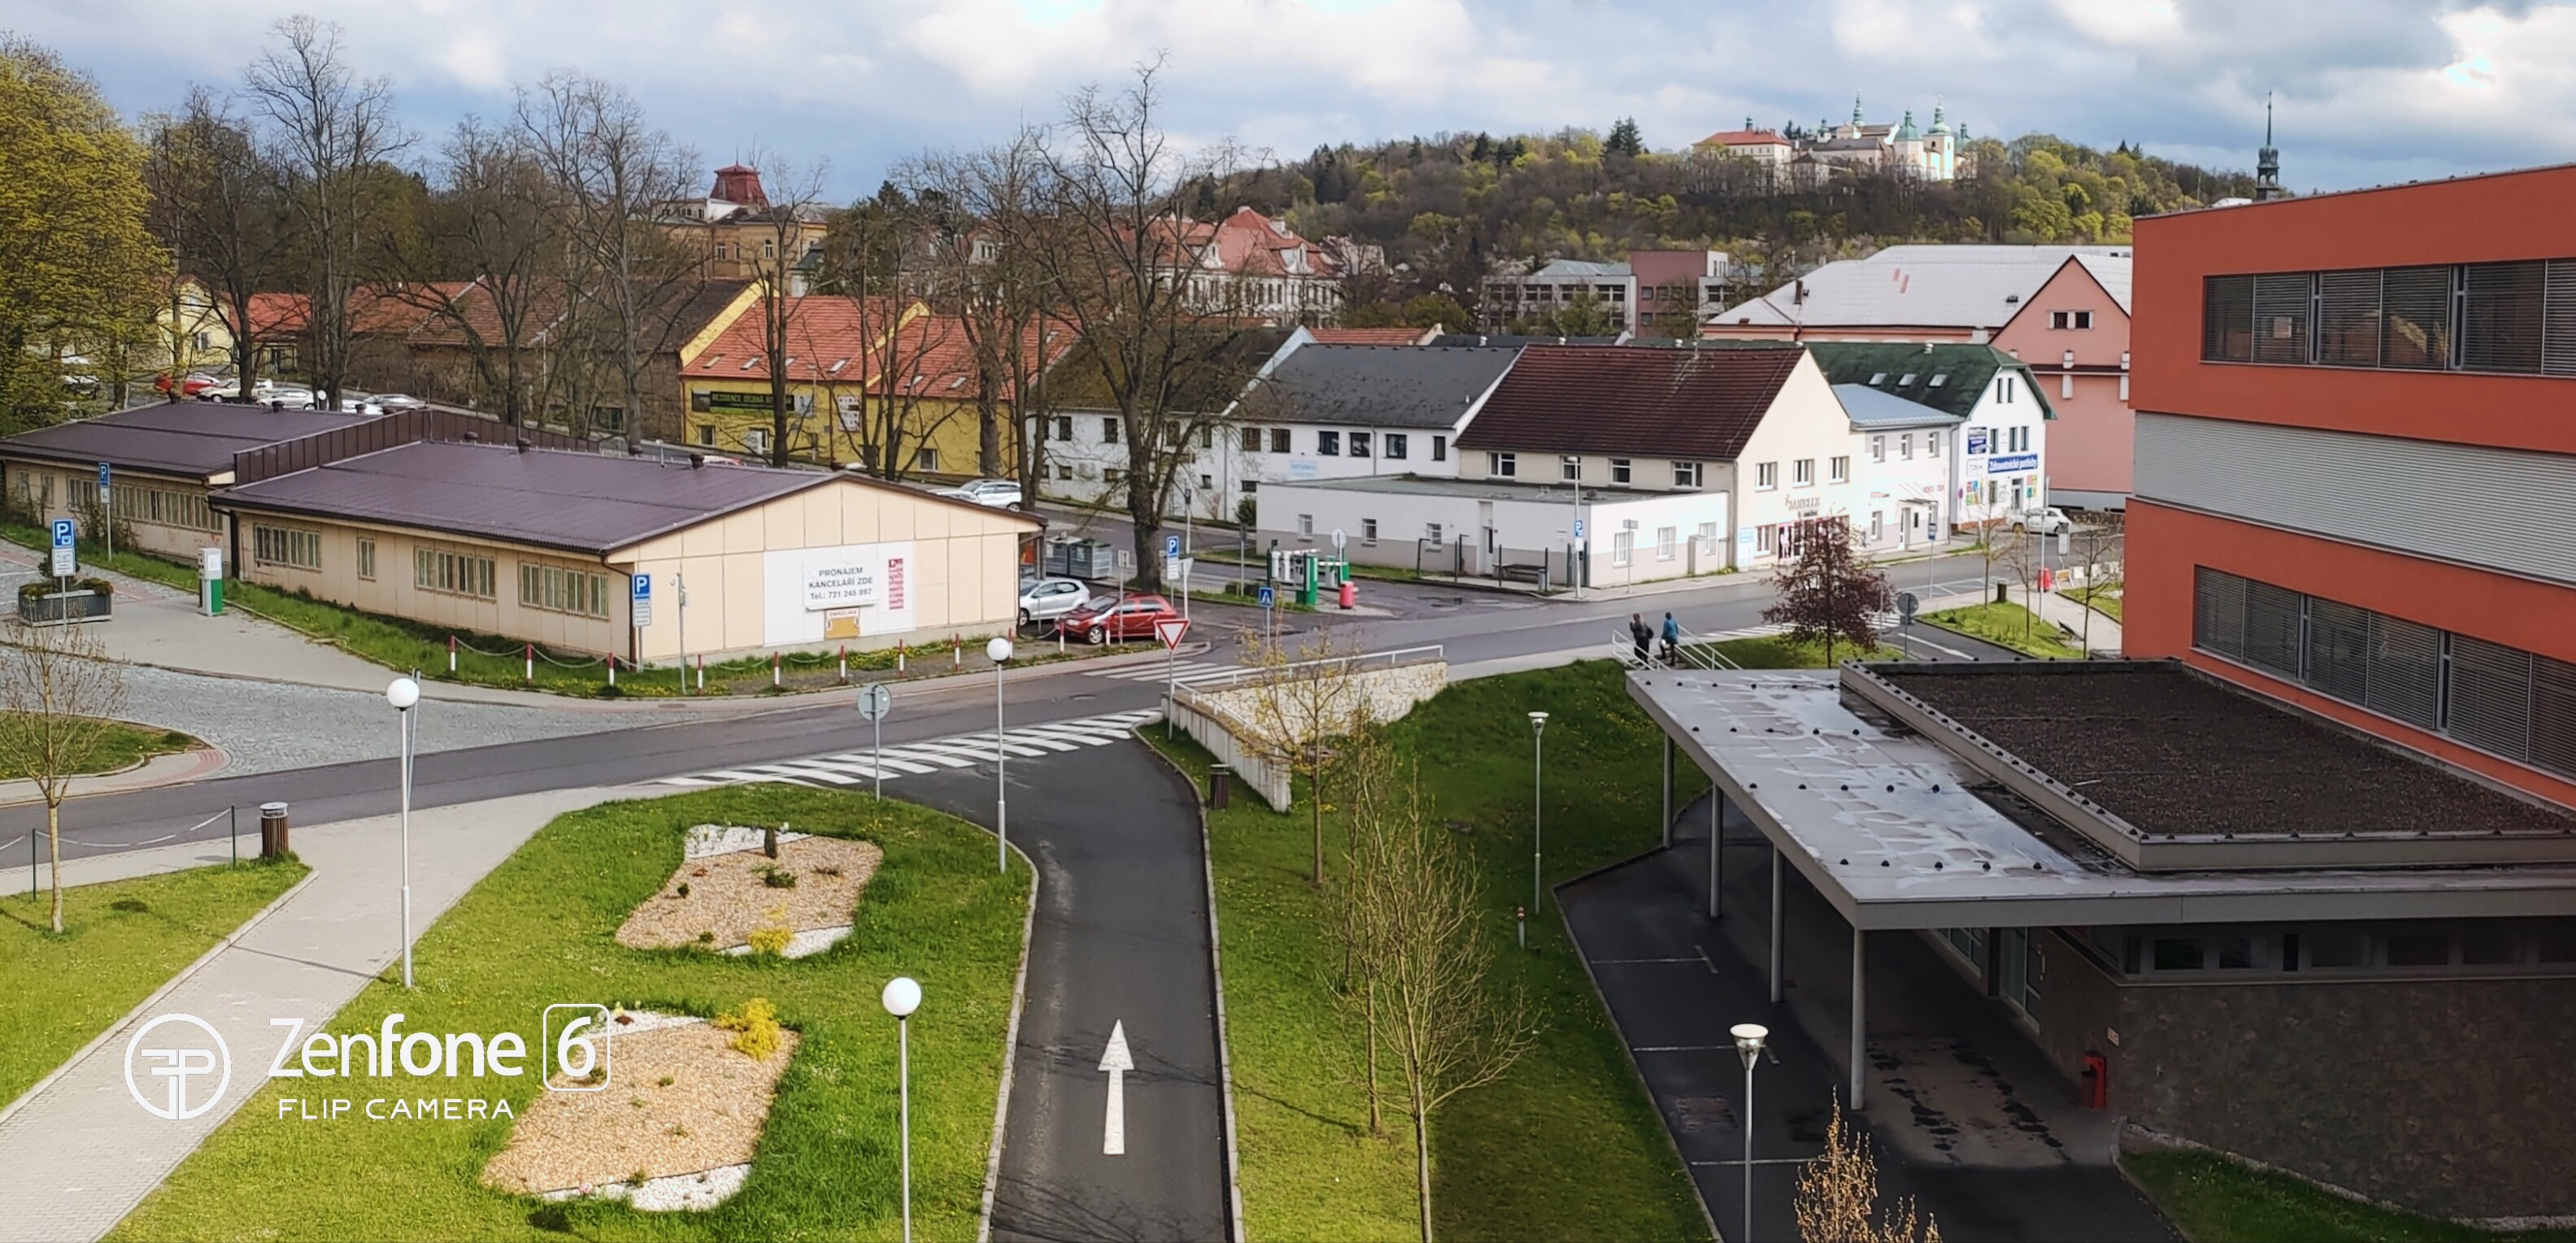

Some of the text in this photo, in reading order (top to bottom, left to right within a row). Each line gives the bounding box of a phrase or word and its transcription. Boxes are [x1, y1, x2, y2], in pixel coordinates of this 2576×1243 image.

[101, 466, 107, 479] P
[56, 523, 69, 539] P
[1169, 539, 1177, 552] P
[819, 567, 863, 576] PRONÁJEM
[636, 576, 647, 593] P
[808, 576, 873, 589] KANCELÁŘÍ ZDE
[829, 591, 841, 599] 721
[844, 589, 856, 598] 245
